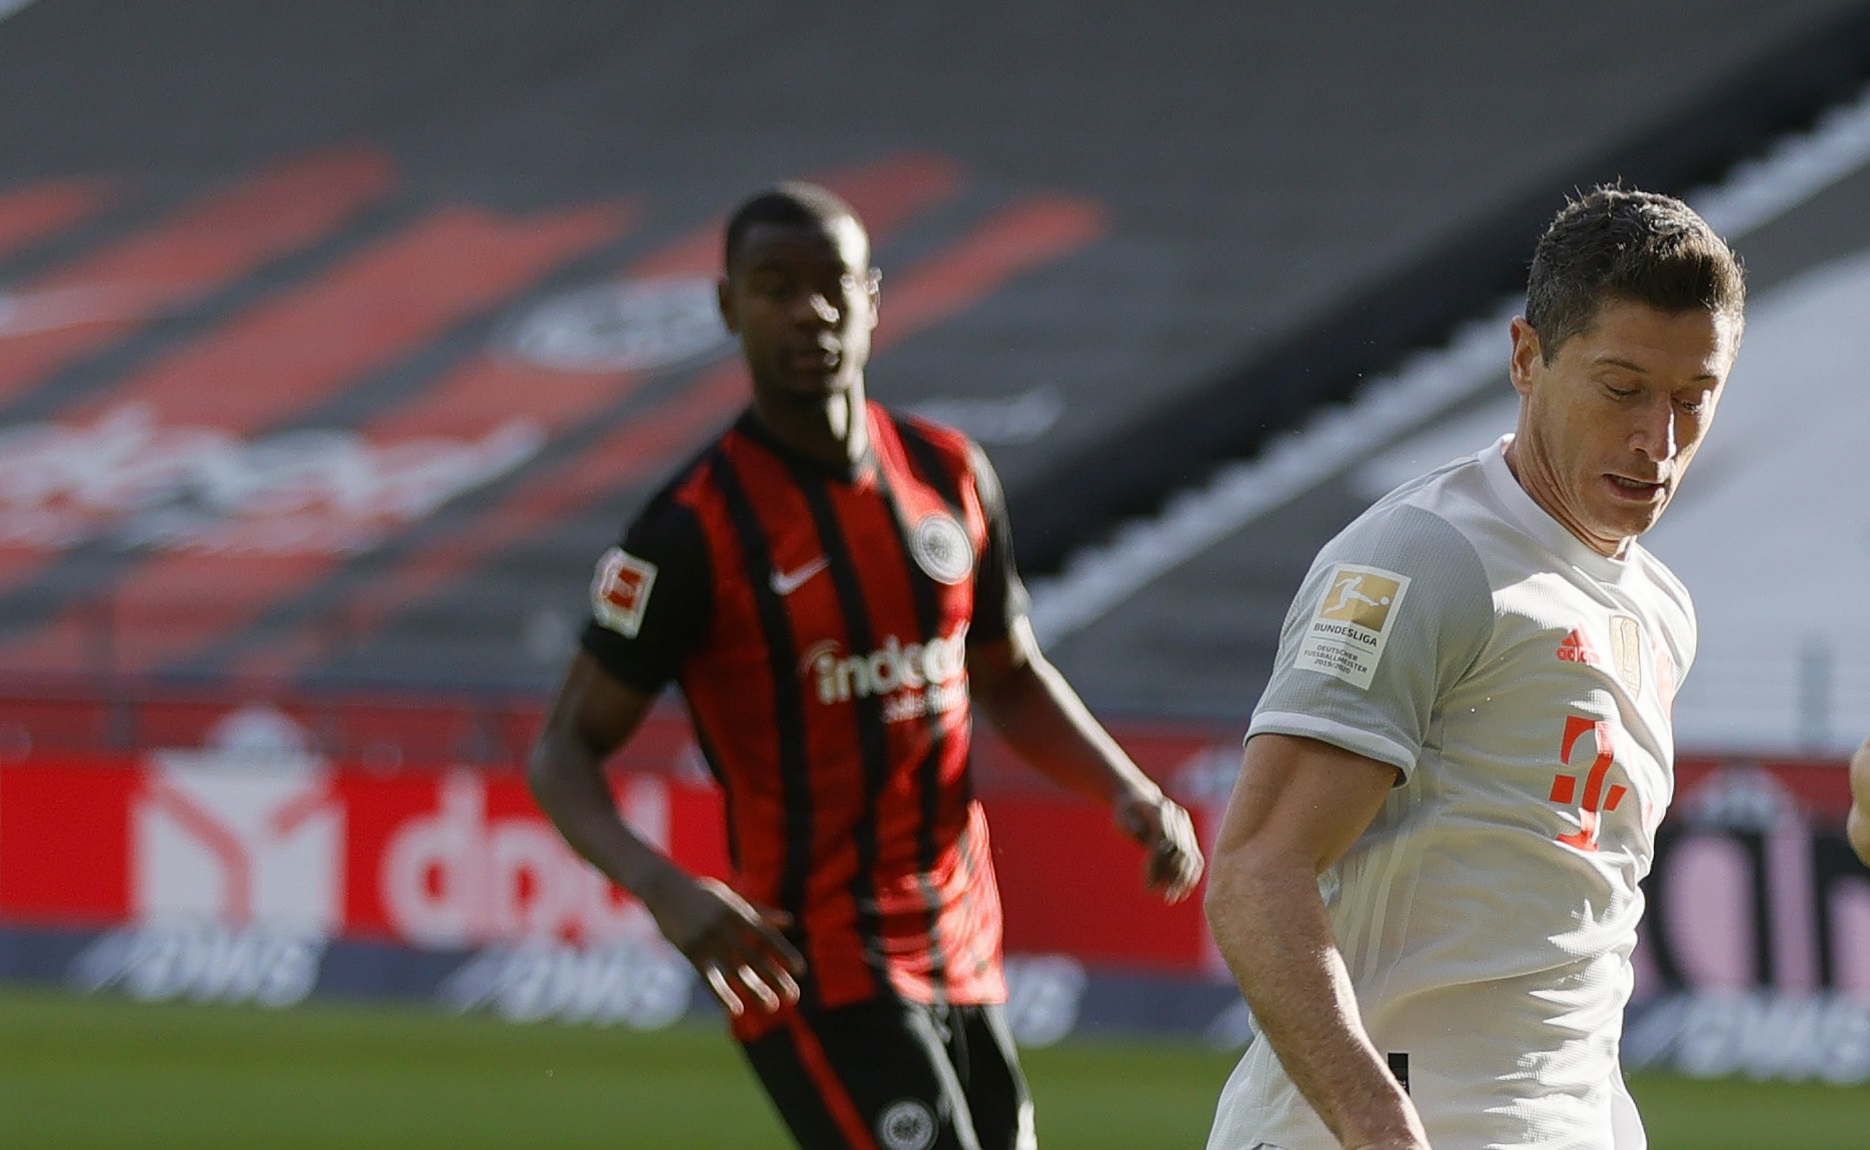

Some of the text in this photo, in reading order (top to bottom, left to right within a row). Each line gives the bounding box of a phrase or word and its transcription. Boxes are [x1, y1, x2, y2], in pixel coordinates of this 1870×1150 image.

[1313, 622, 1378, 647] BUNDESLIGA
[1304, 649, 1368, 673] FUSSBALLMEISTER
[1317, 644, 1358, 661] DEUTSCHER
[1314, 658, 1351, 675] 2019/2020
